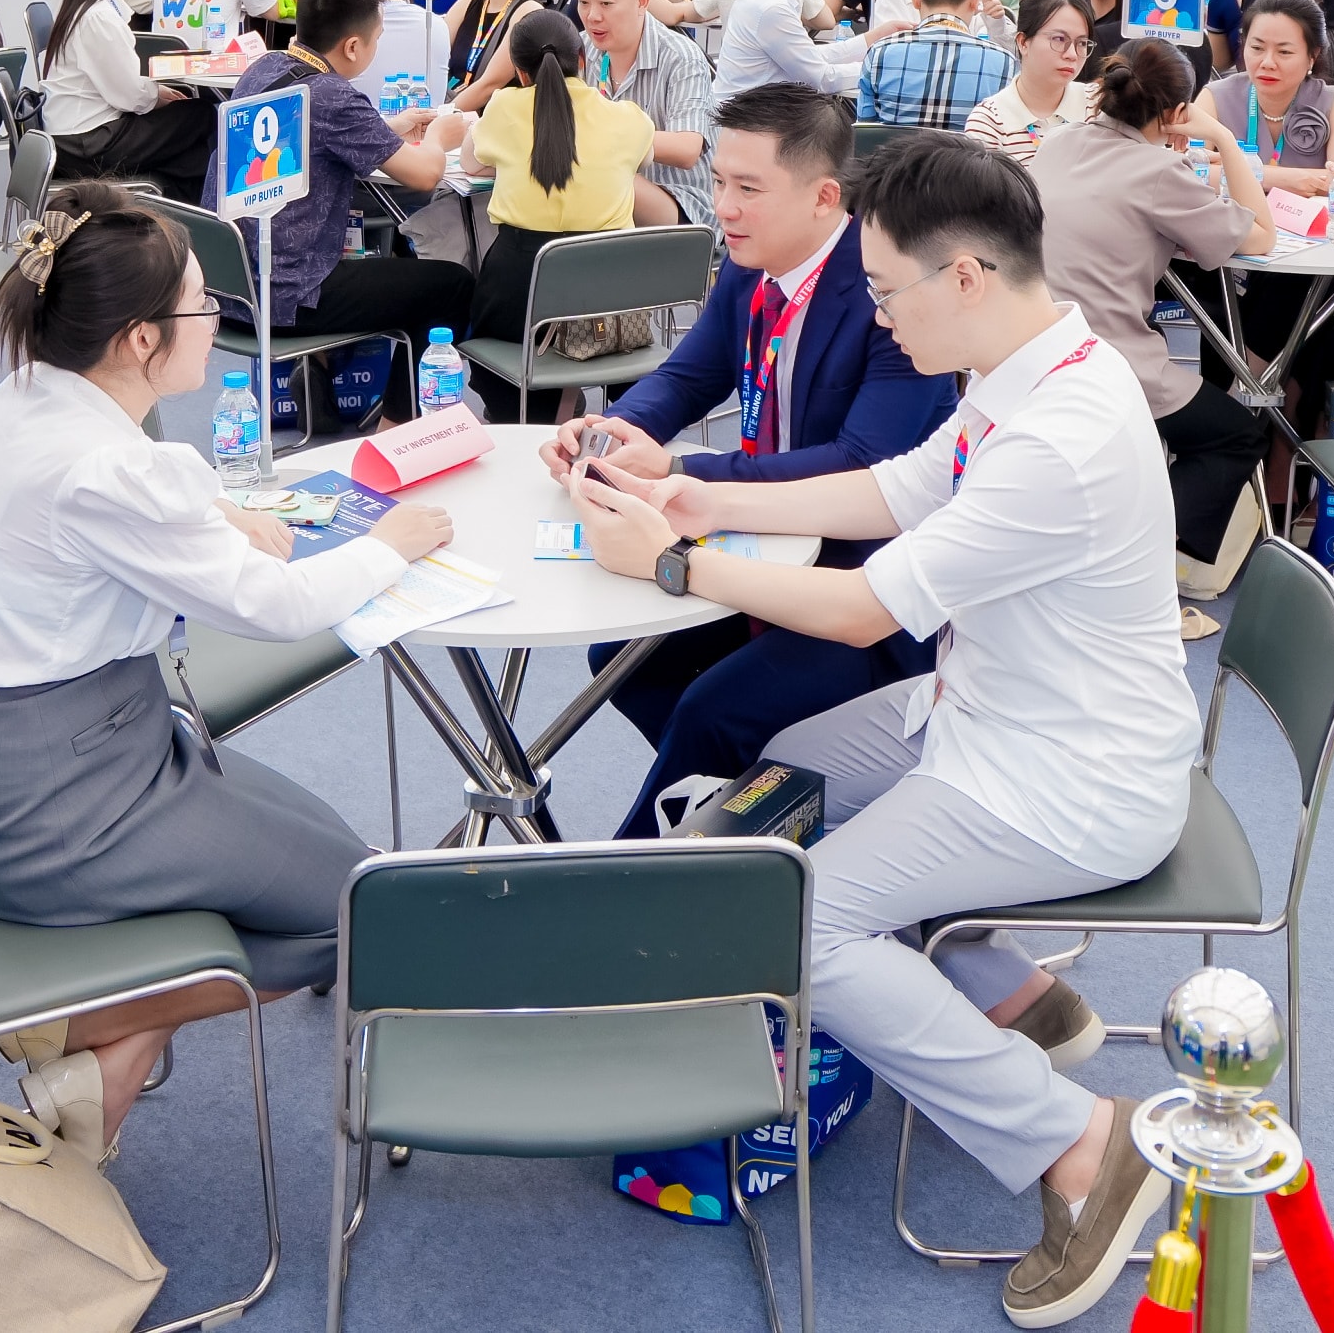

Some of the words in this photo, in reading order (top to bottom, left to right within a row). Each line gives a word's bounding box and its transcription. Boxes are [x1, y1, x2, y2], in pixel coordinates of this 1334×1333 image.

[1145, 29, 1156, 37] VIP
[1157, 31, 1181, 39] BUYER
[261, 116, 271, 143] 1
[243, 193, 258, 207] VIP
[258, 185, 284, 203] BUYER
[1155, 308, 1186, 321] EVENT
[353, 371, 372, 384] TO
[277, 401, 298, 413] IBT
[751, 391, 762, 418] HANOI
[393, 443, 409, 457] ULY
[409, 427, 455, 450] INVESTMENT
[825, 1091, 855, 1135] YOU
